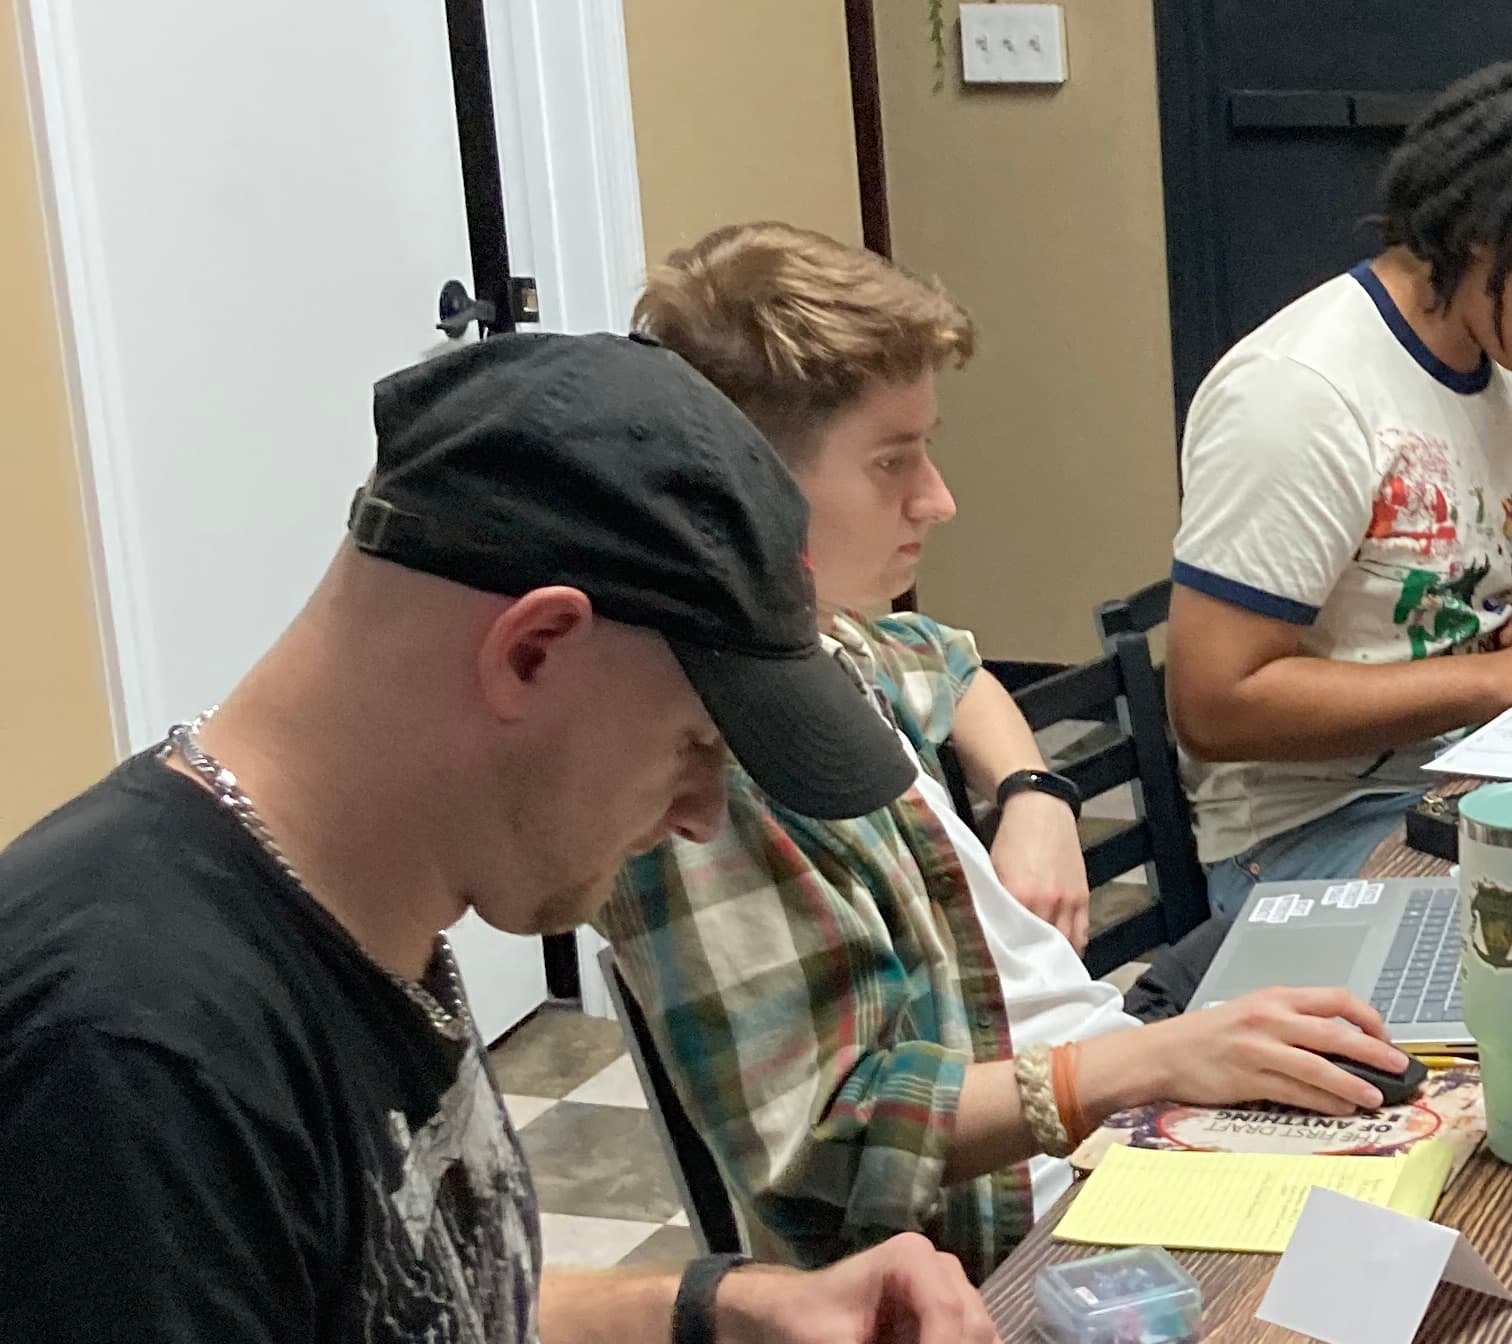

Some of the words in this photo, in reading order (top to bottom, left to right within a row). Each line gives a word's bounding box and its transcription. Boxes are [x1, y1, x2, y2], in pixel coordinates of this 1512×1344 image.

[1203, 1120, 1280, 1135] DRAFT
[1214, 1110, 1353, 1130] ANYTHING
[1280, 1127, 1339, 1142] FIRST
[1360, 1124, 1393, 1133] OF
[1339, 1132, 1382, 1145] THE
